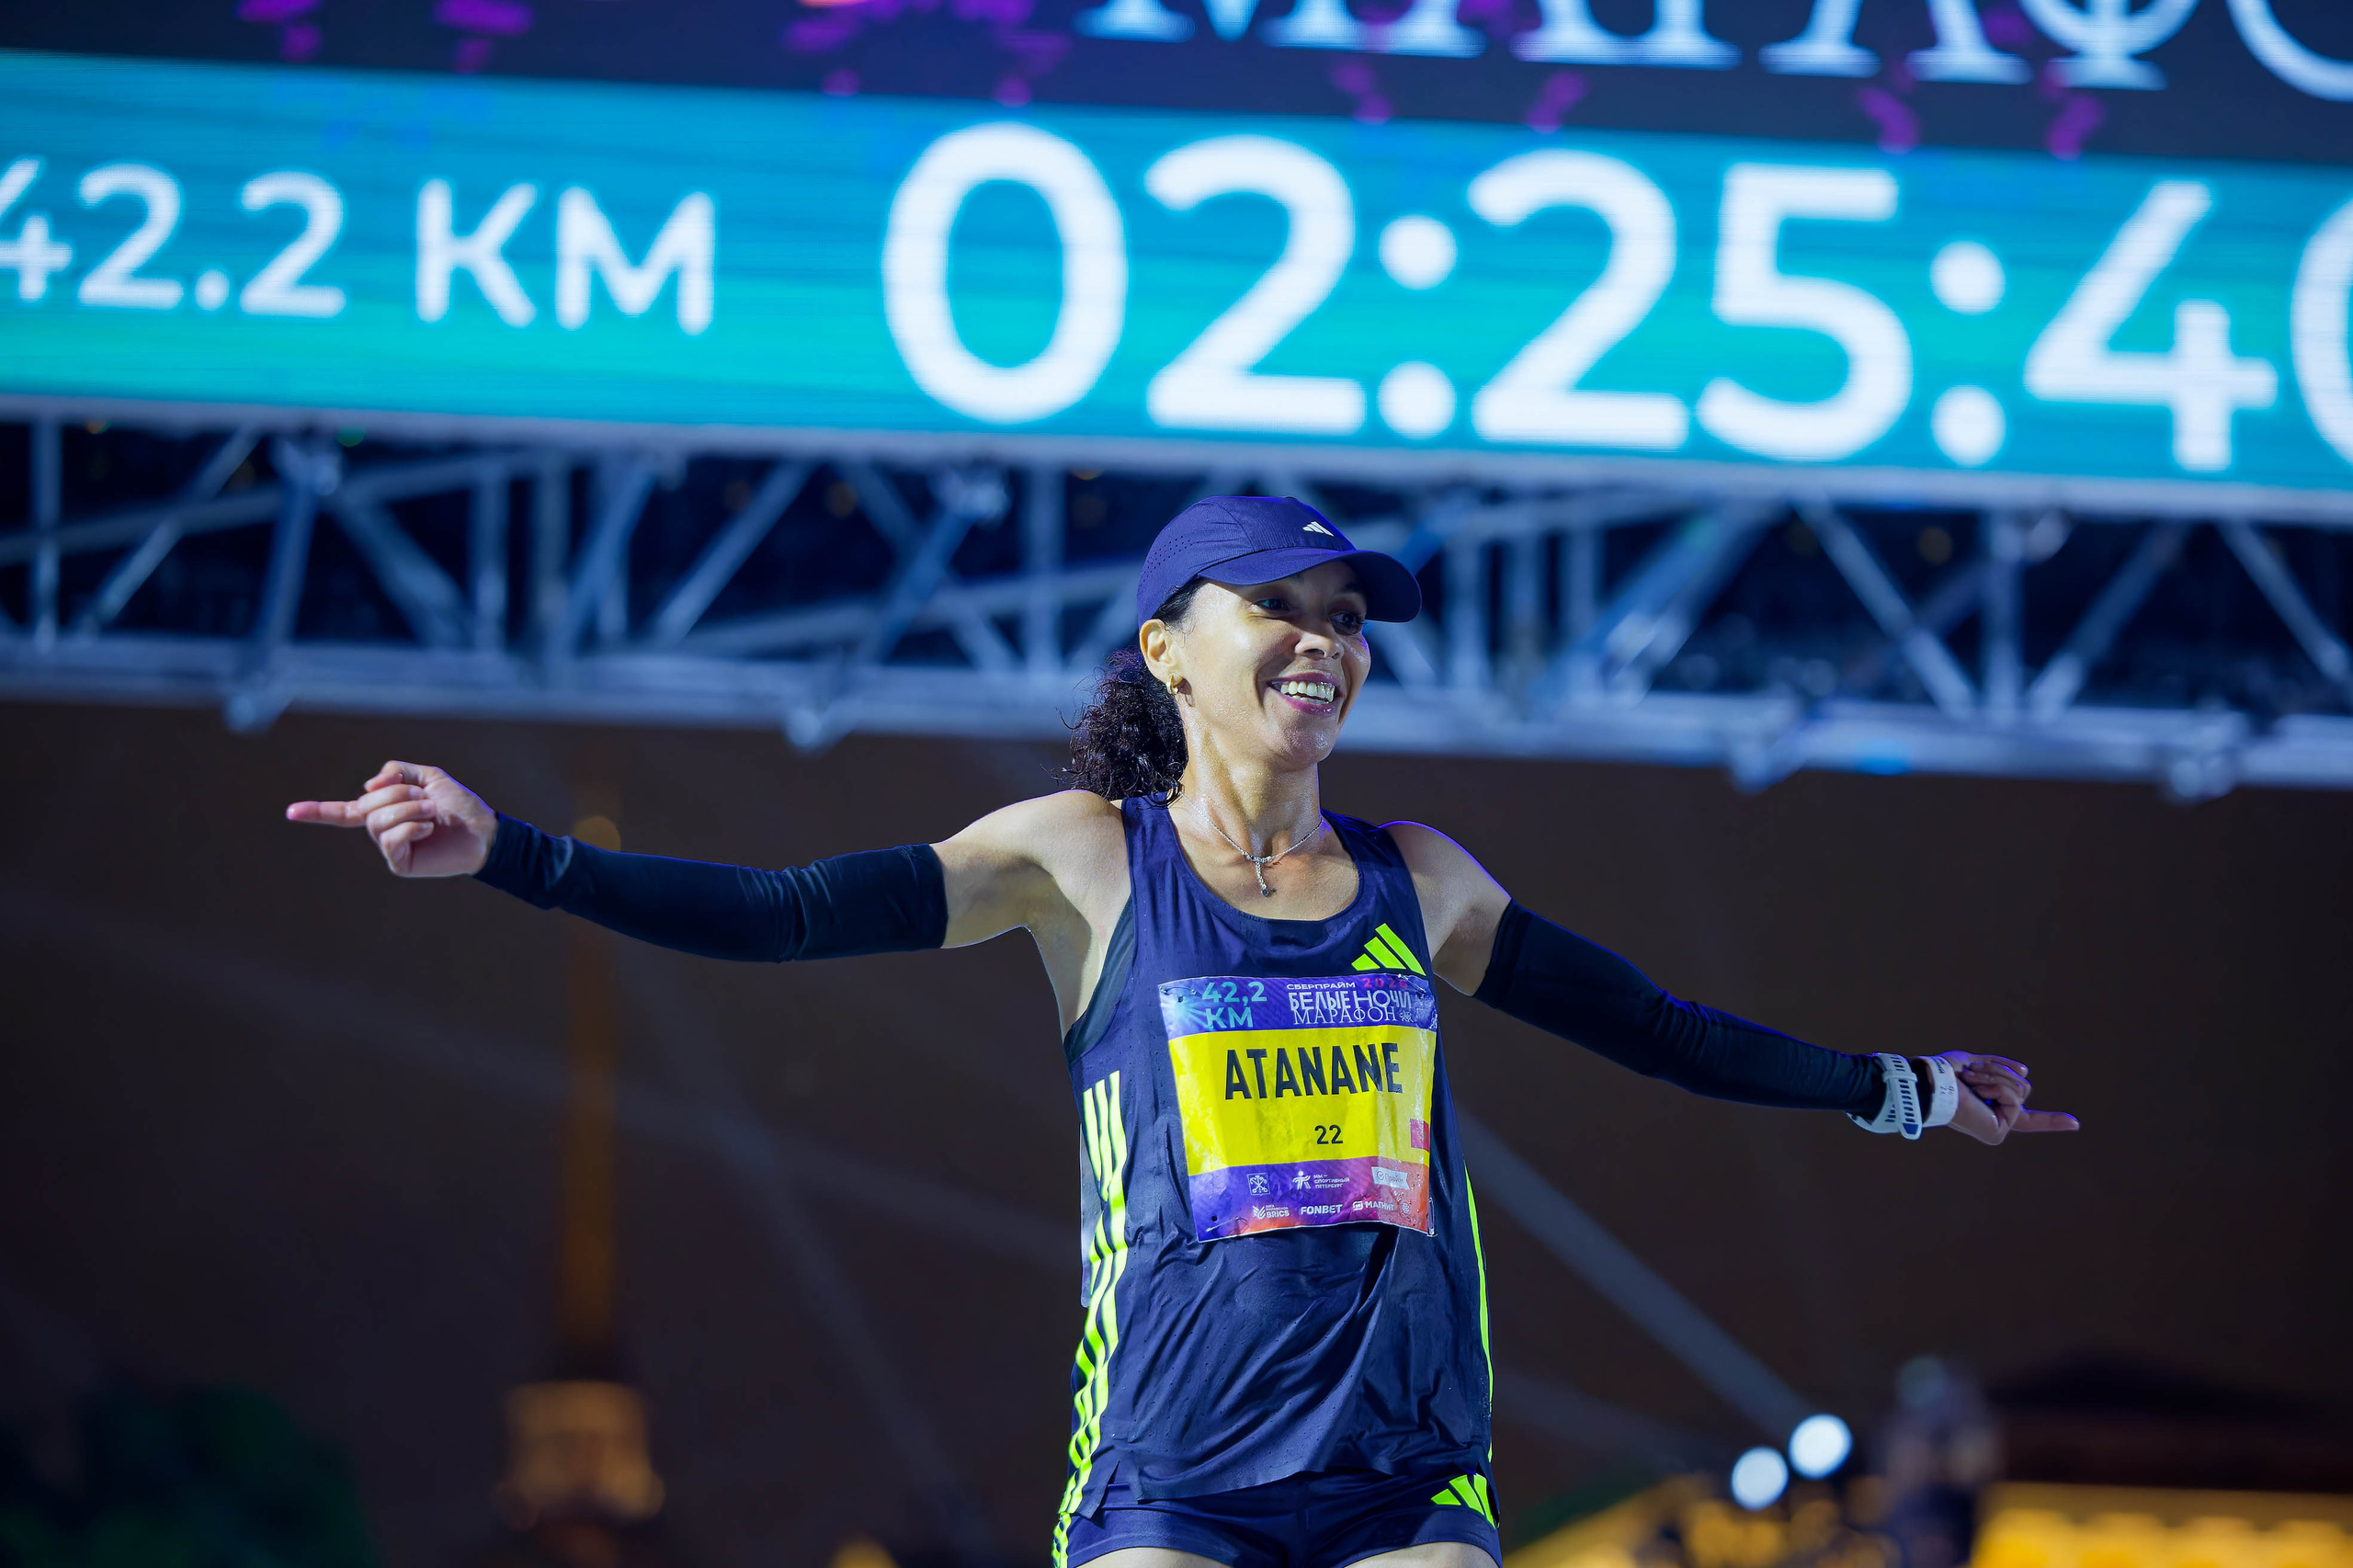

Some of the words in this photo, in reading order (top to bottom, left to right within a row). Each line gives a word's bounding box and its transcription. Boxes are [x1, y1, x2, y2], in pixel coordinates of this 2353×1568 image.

[0, 154, 347, 319] 42.2
[414, 178, 716, 335] КМ
[881, 121, 2353, 472] 02:25:4
[1201, 981, 1267, 1005] 42,2
[1286, 982, 1356, 990] СБЕРПРАЙМ
[1289, 991, 1351, 1011] БЕЛЫЕ
[1353, 990, 1412, 1009] НОЧИ
[1206, 1006, 1254, 1028] КМ
[1293, 1006, 1397, 1025] МАРАФОН
[1225, 1042, 1403, 1100] ATANANE
[1314, 1125, 1344, 1144] 22
[1266, 1210, 1290, 1219] BRICS
[1301, 1204, 1343, 1215] FONBET
[1365, 1200, 1394, 1211] МАГНИТ
